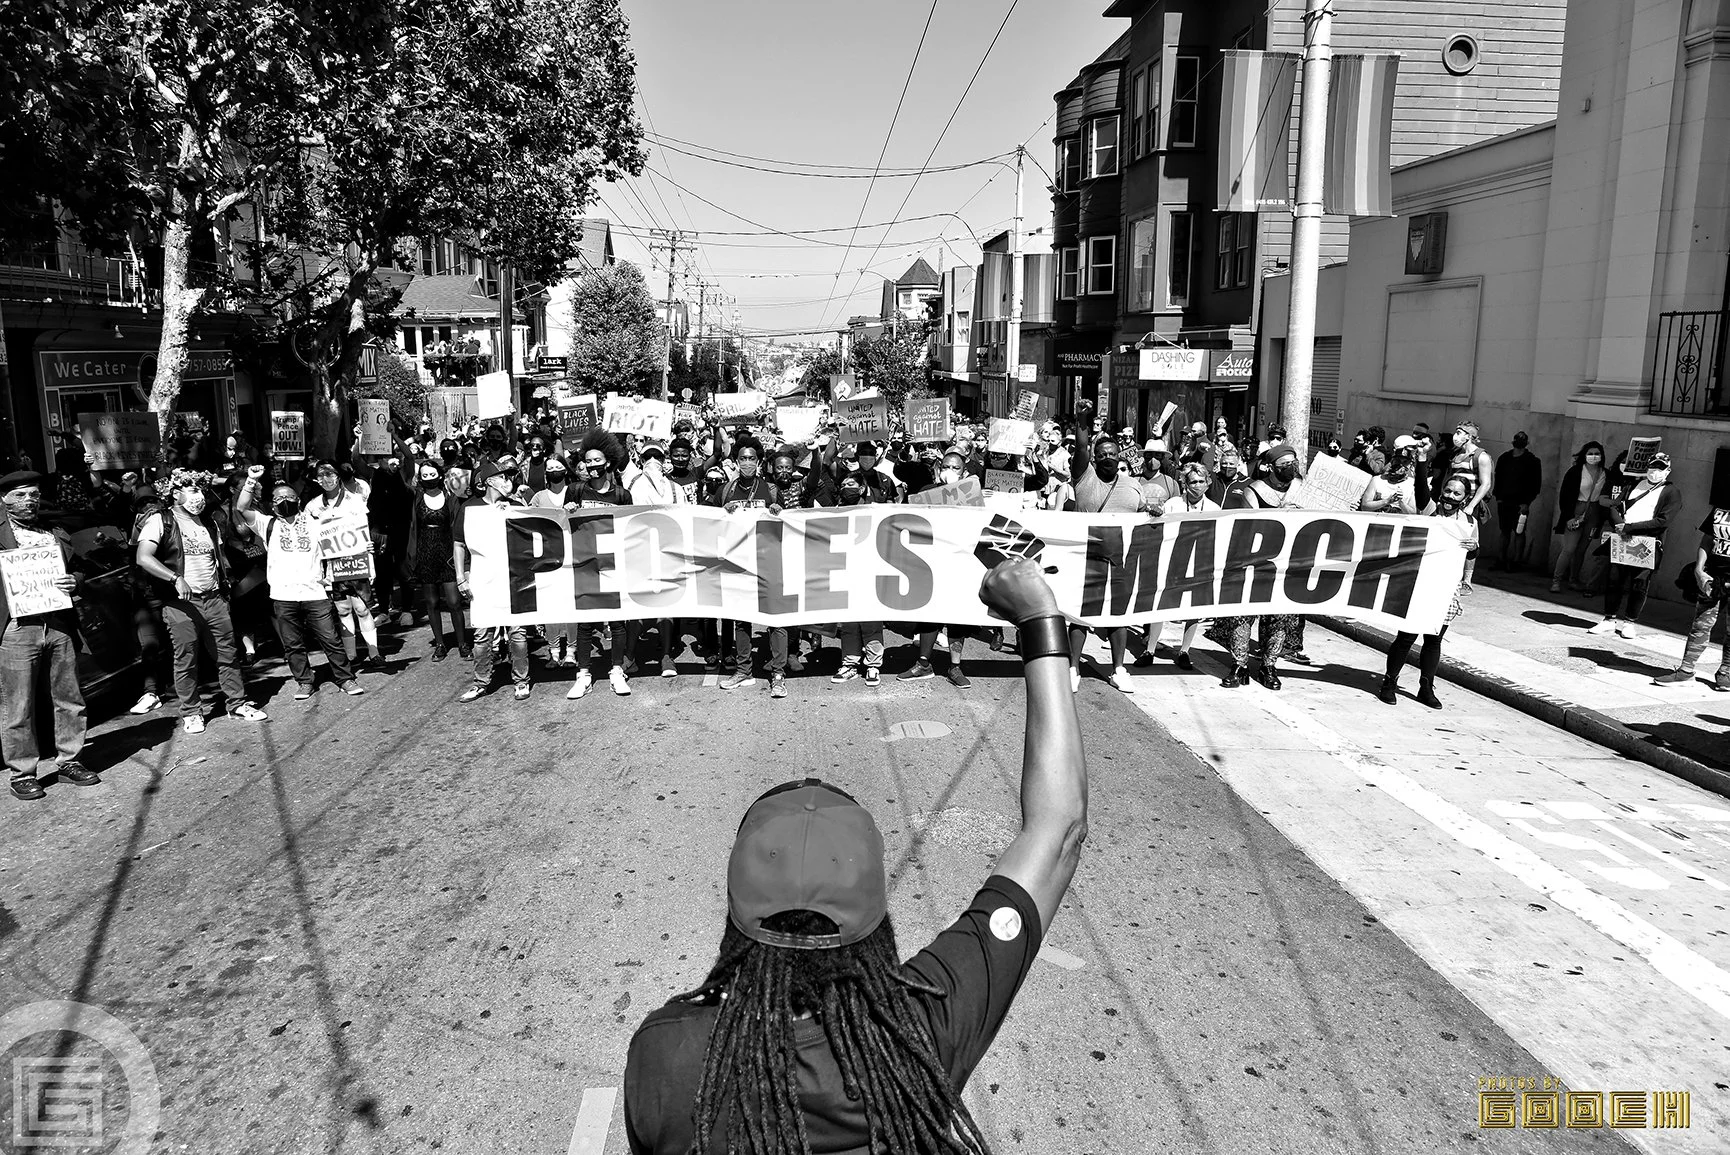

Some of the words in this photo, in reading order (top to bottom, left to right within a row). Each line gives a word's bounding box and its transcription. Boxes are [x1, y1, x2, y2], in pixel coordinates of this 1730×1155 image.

[1151, 351, 1196, 364] DASHING
[1216, 353, 1253, 368] Auto
[54, 362, 80, 378] We
[84, 360, 127, 377] Cater
[563, 409, 588, 420] BLACK
[608, 411, 660, 431] RIOT
[564, 417, 589, 429] LIVES
[848, 419, 879, 437] HATE
[912, 419, 944, 437] HATE
[278, 430, 299, 441] OUT
[275, 441, 302, 451] NOW!
[318, 524, 371, 558] RIOT
[505, 513, 935, 615] PEOPLE'S
[1080, 518, 1430, 620] MARCH
